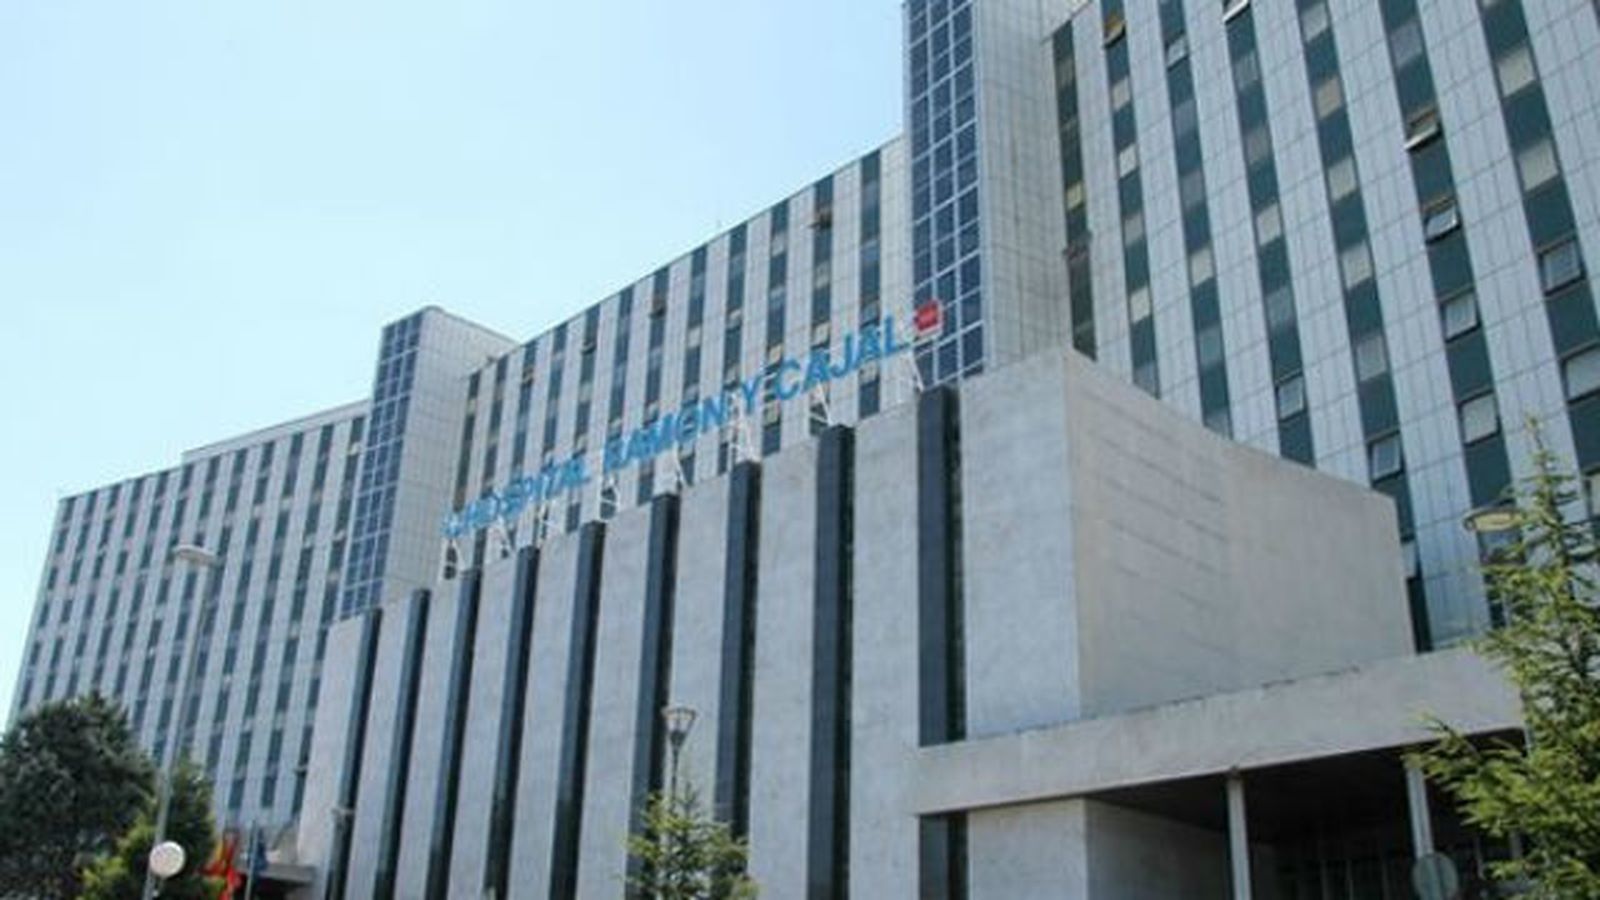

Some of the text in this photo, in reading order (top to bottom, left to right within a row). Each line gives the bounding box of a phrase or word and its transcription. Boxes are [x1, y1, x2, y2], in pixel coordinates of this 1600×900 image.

[463, 456, 591, 529] HOSPITAL
[741, 374, 764, 415] Y
[776, 314, 909, 399] CAJAL
